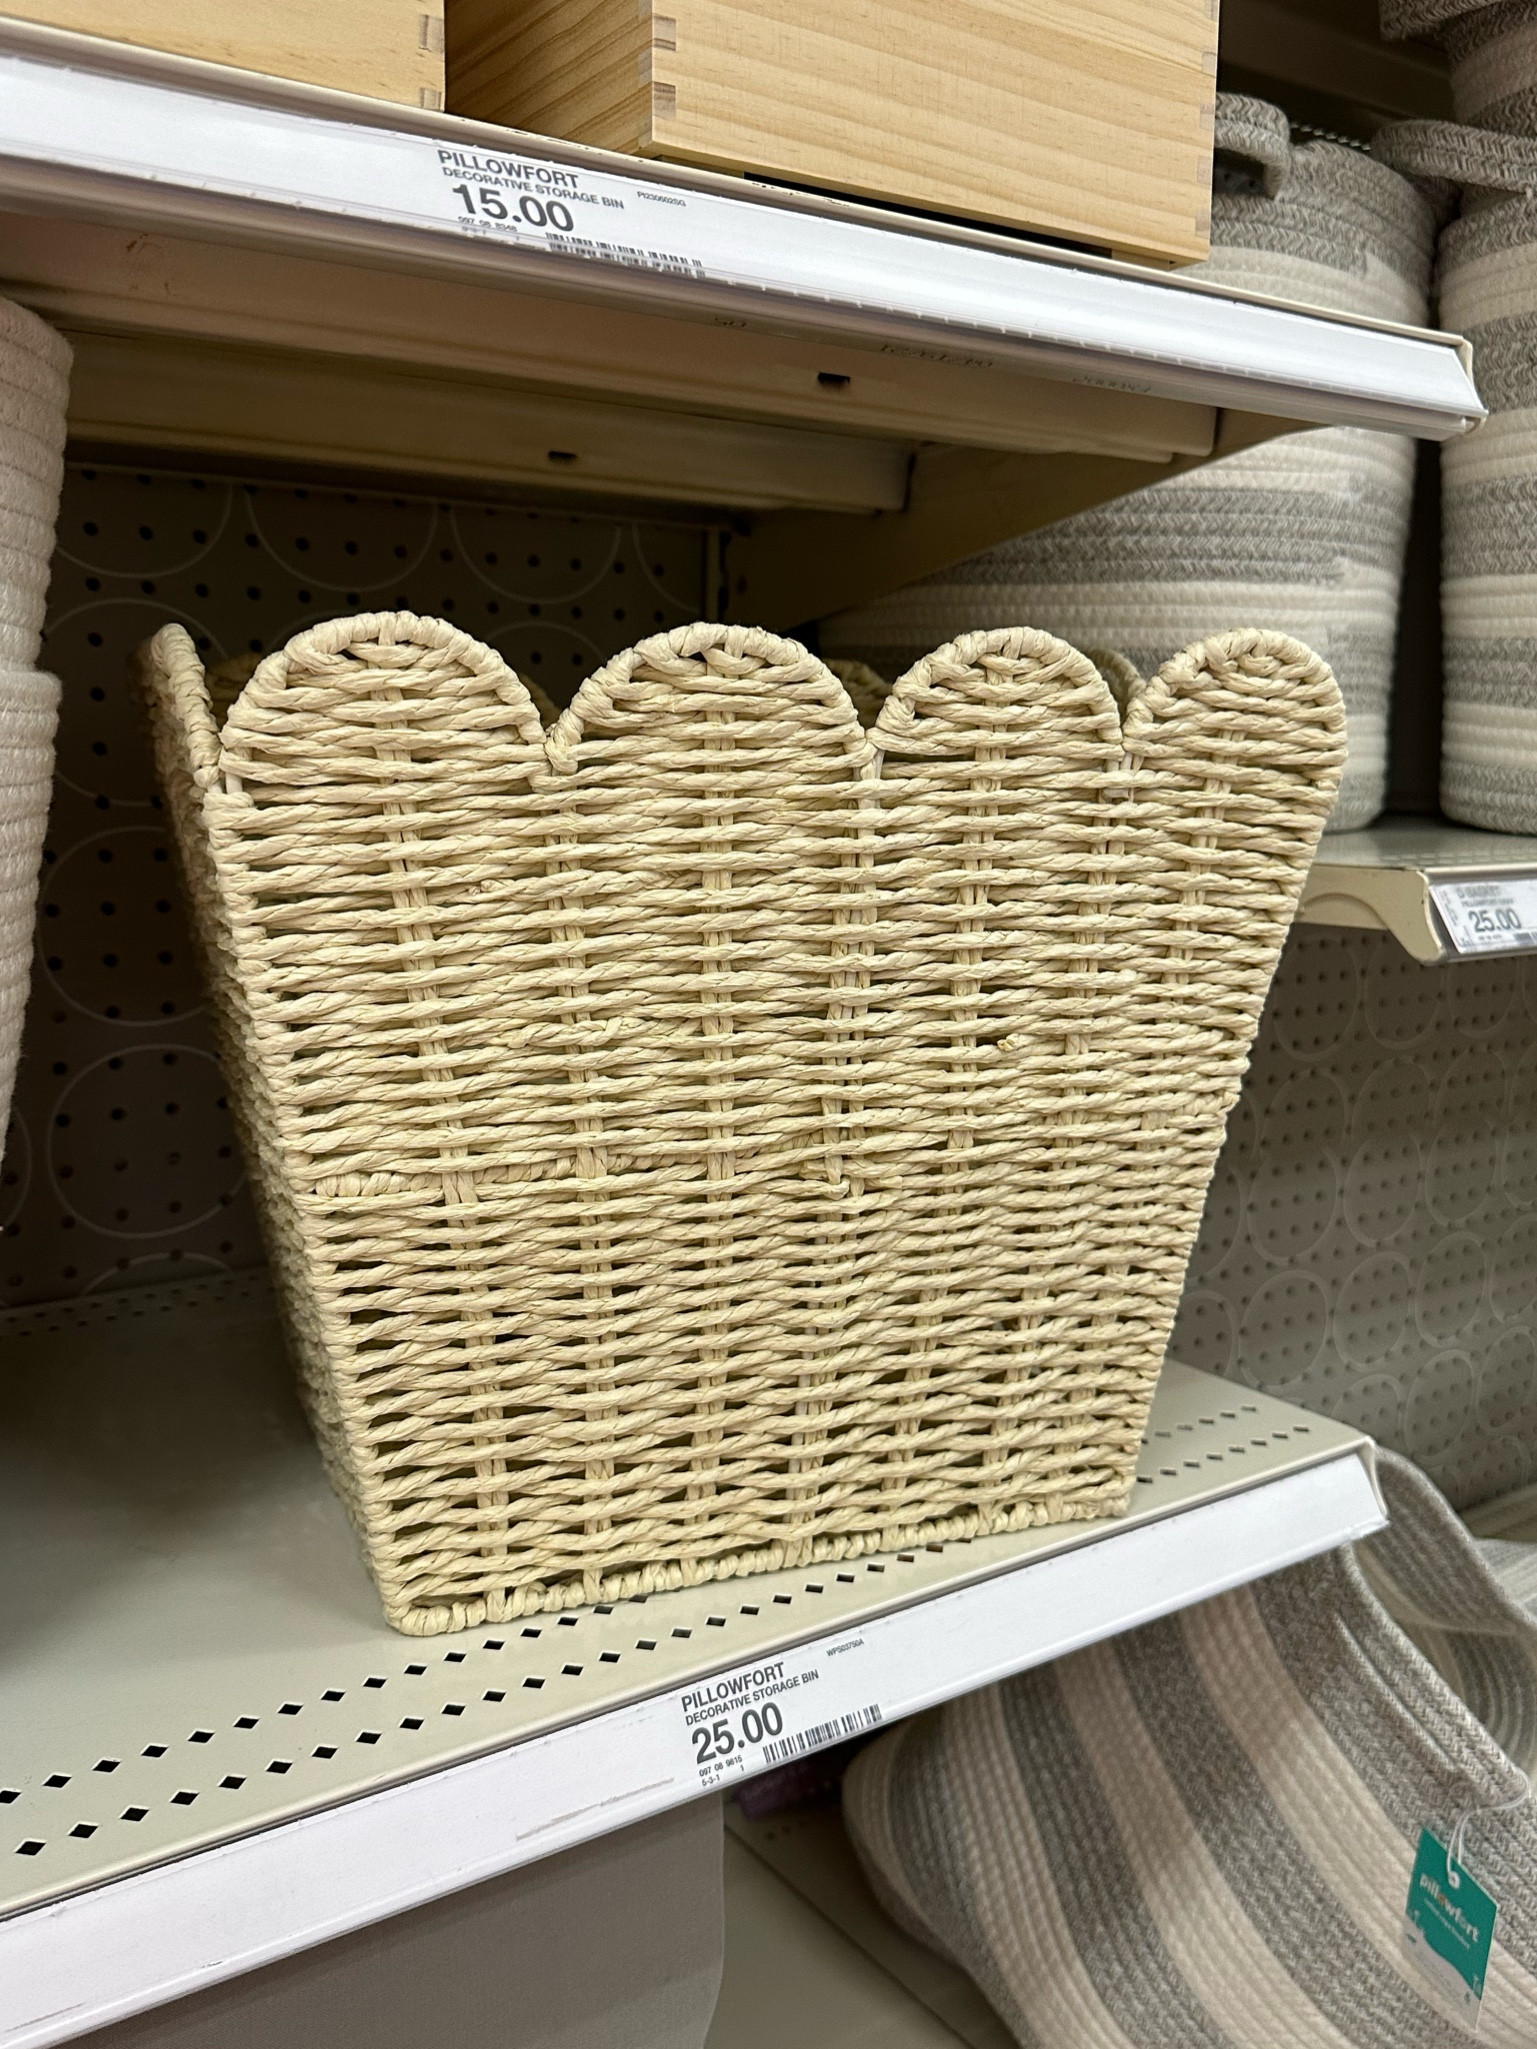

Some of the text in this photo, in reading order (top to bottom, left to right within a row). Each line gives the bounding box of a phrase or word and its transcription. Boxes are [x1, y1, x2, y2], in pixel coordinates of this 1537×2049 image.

[437, 149, 579, 189] PILLOWFORT
[442, 166, 625, 210] DECORATIVE STORAGE BIN
[452, 183, 574, 232] 15.00
[1467, 908, 1523, 933] 25.00
[681, 1661, 785, 1713] PILLOWFORT
[685, 1668, 820, 1726] DECORATIVE STORAGE BIN
[691, 1702, 784, 1765] 25.00
[698, 1765, 712, 1777] 097
[714, 1761, 724, 1772] 08
